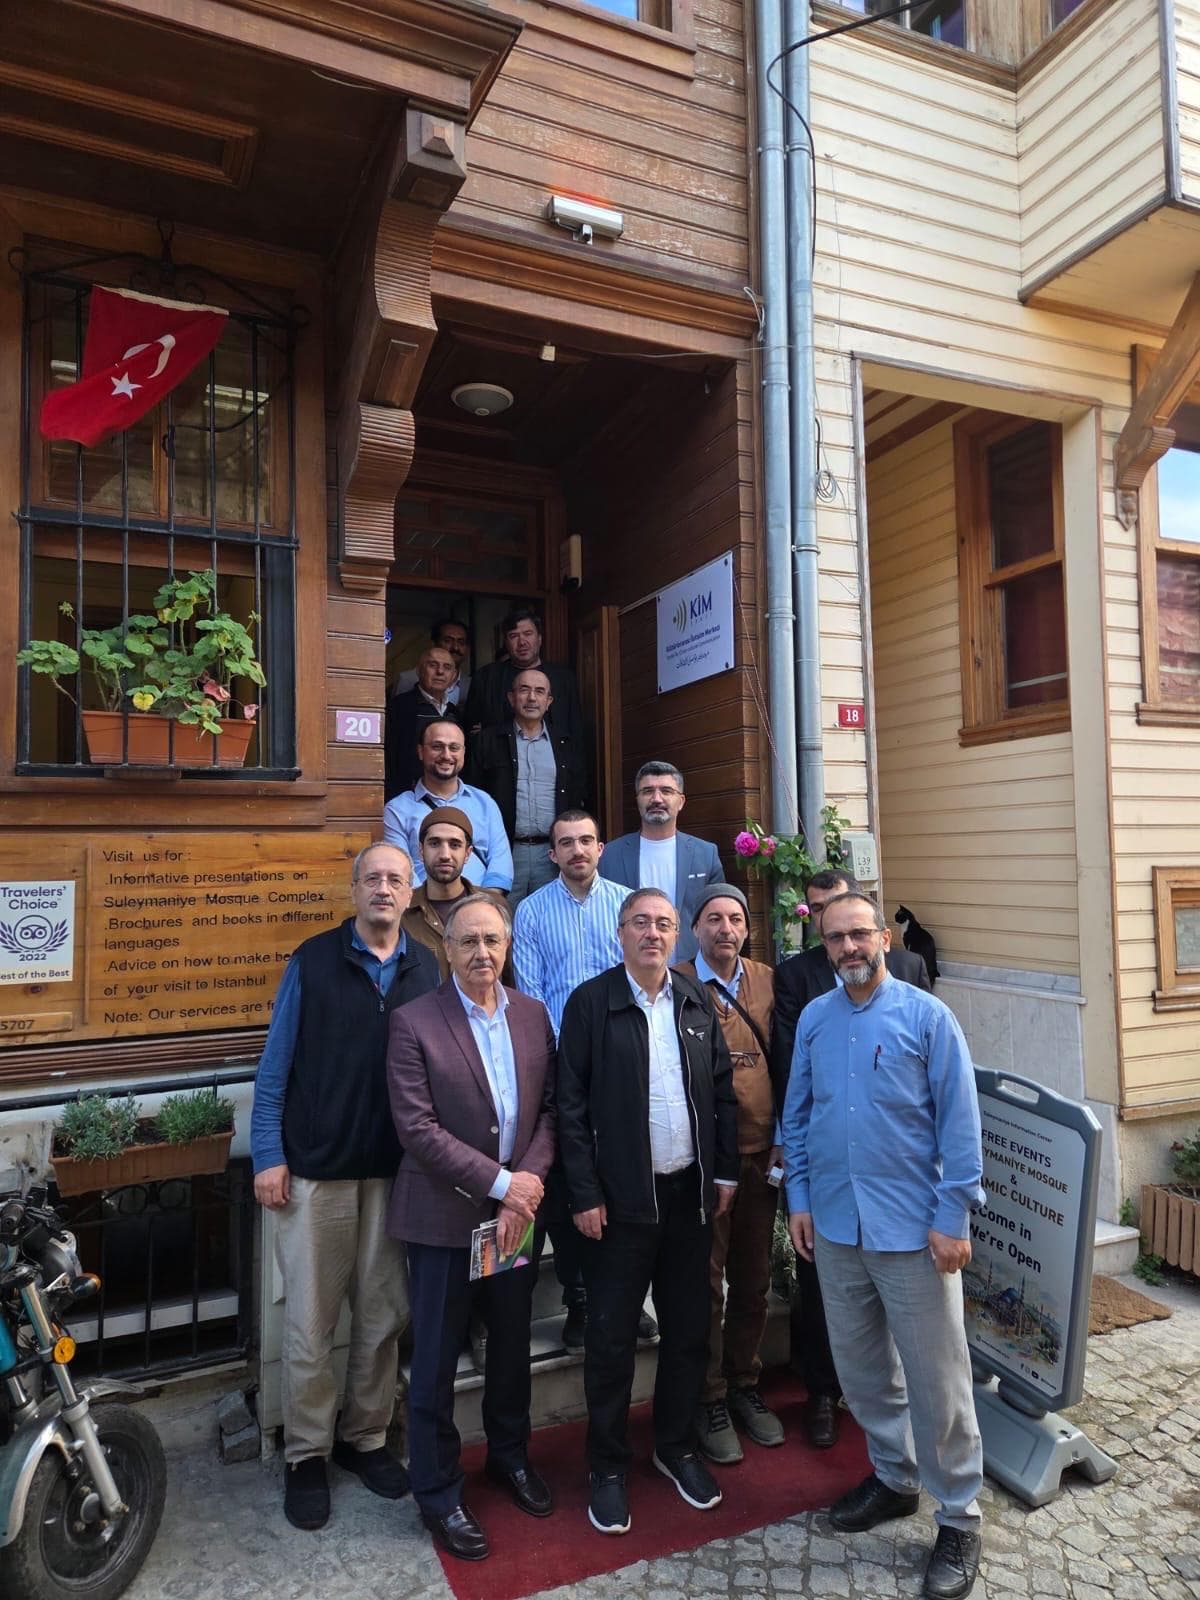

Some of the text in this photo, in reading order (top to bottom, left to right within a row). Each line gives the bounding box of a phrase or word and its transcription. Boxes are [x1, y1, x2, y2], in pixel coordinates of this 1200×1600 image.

[846, 709, 859, 722] 18
[344, 716, 372, 737] 20
[103, 850, 134, 862] Visit
[143, 853, 160, 861] us
[165, 850, 184, 861] for
[194, 871, 285, 885] presentations
[293, 871, 309, 881] on
[9, 899, 59, 910] Choice
[103, 891, 325, 909] Suleymaniye Mosque Complex
[192, 914, 218, 927] and
[222, 913, 263, 926] books
[267, 912, 278, 923] in
[281, 910, 335, 923] different
[104, 937, 180, 952] languages
[19, 953, 47, 961] 2022
[161, 960, 180, 969] on
[184, 956, 214, 968] how
[217, 955, 230, 966] to
[234, 953, 271, 965] make
[275, 952, 290, 962] be
[103, 975, 266, 997] of your visit to Istanbul
[104, 1012, 143, 1024] Note:
[148, 1008, 176, 1020] Our
[179, 1003, 237, 1018] services
[240, 1003, 263, 1014] are
[981, 1129, 1051, 1168] FREE EVENTS
[1010, 1174, 1018, 1186] &
[1028, 1167, 1068, 1193] MOSQUE
[1010, 1190, 1065, 1227] CULTURE
[978, 1205, 1032, 1241] Come in
[1008, 1242, 1042, 1273] Open
